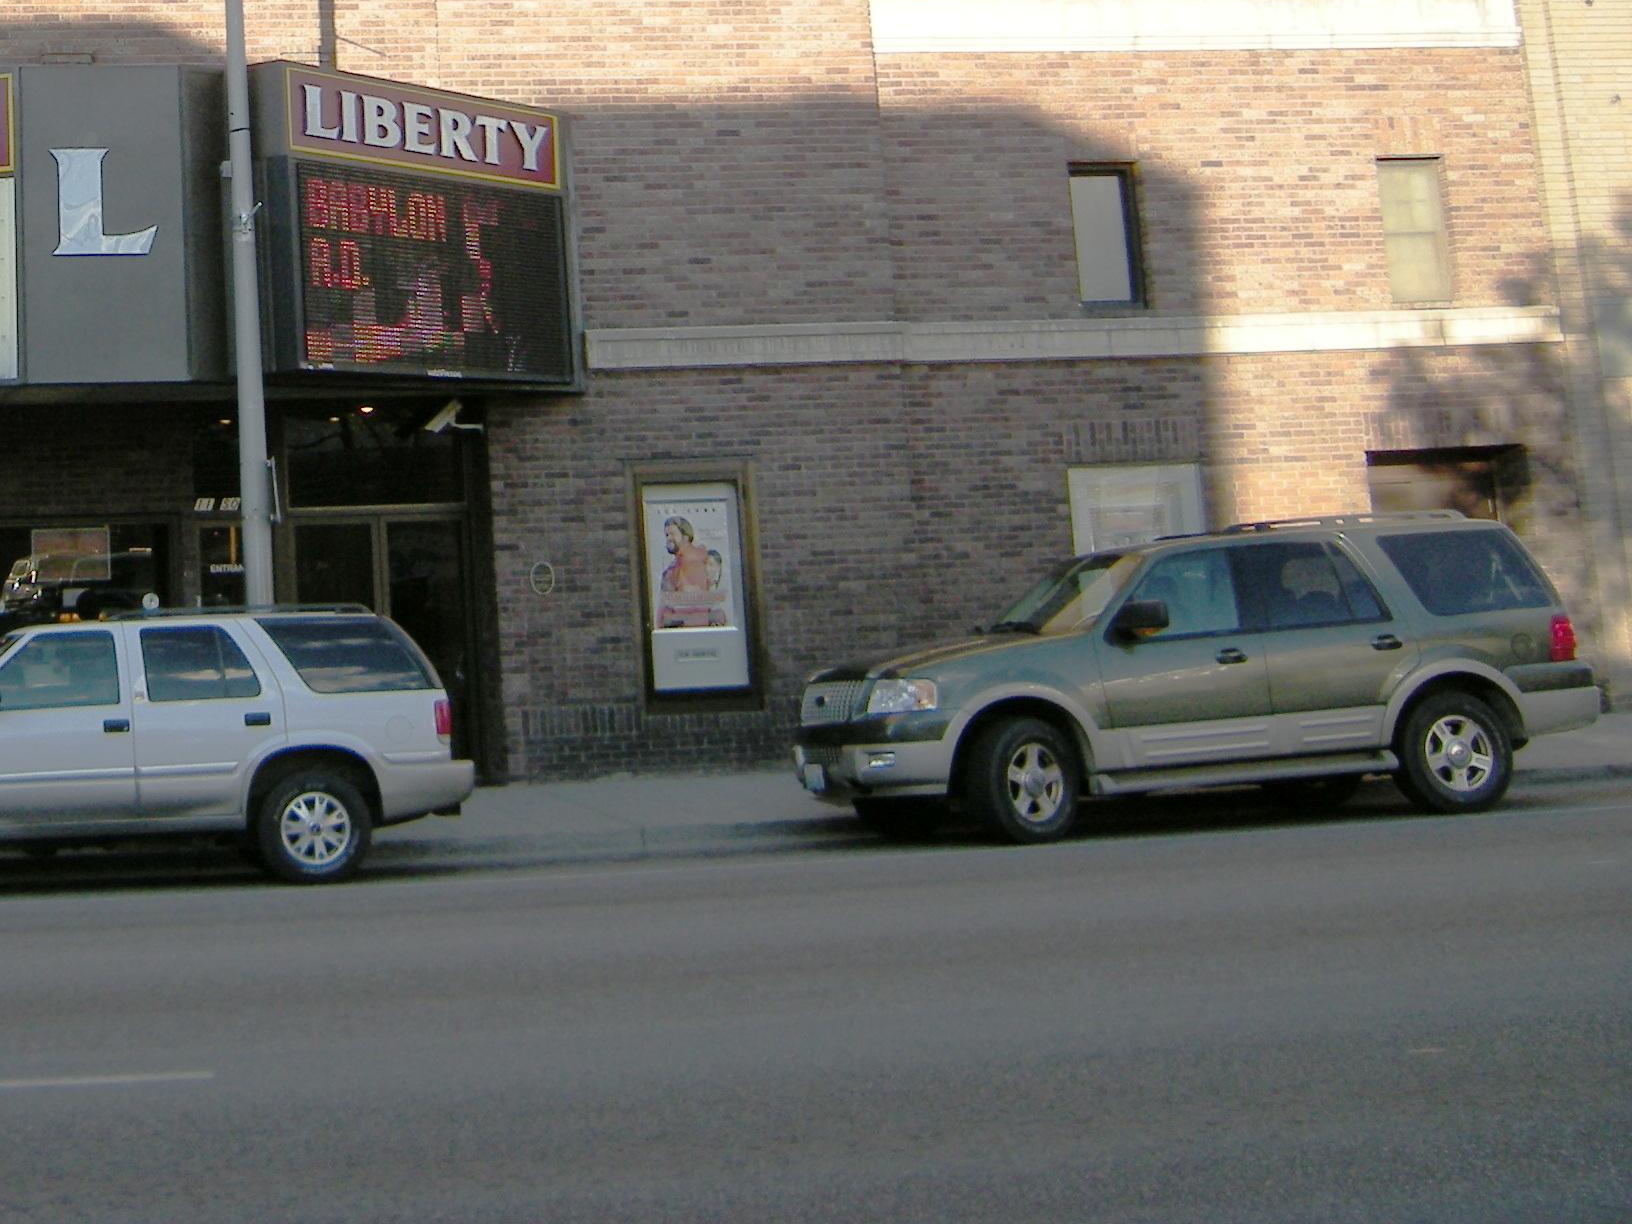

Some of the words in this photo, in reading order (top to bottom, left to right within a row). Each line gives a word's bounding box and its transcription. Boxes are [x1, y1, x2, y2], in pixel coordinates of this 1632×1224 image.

[303, 84, 548, 172] LIBERTY
[48, 147, 159, 256] L
[305, 177, 447, 242] BABYLON
